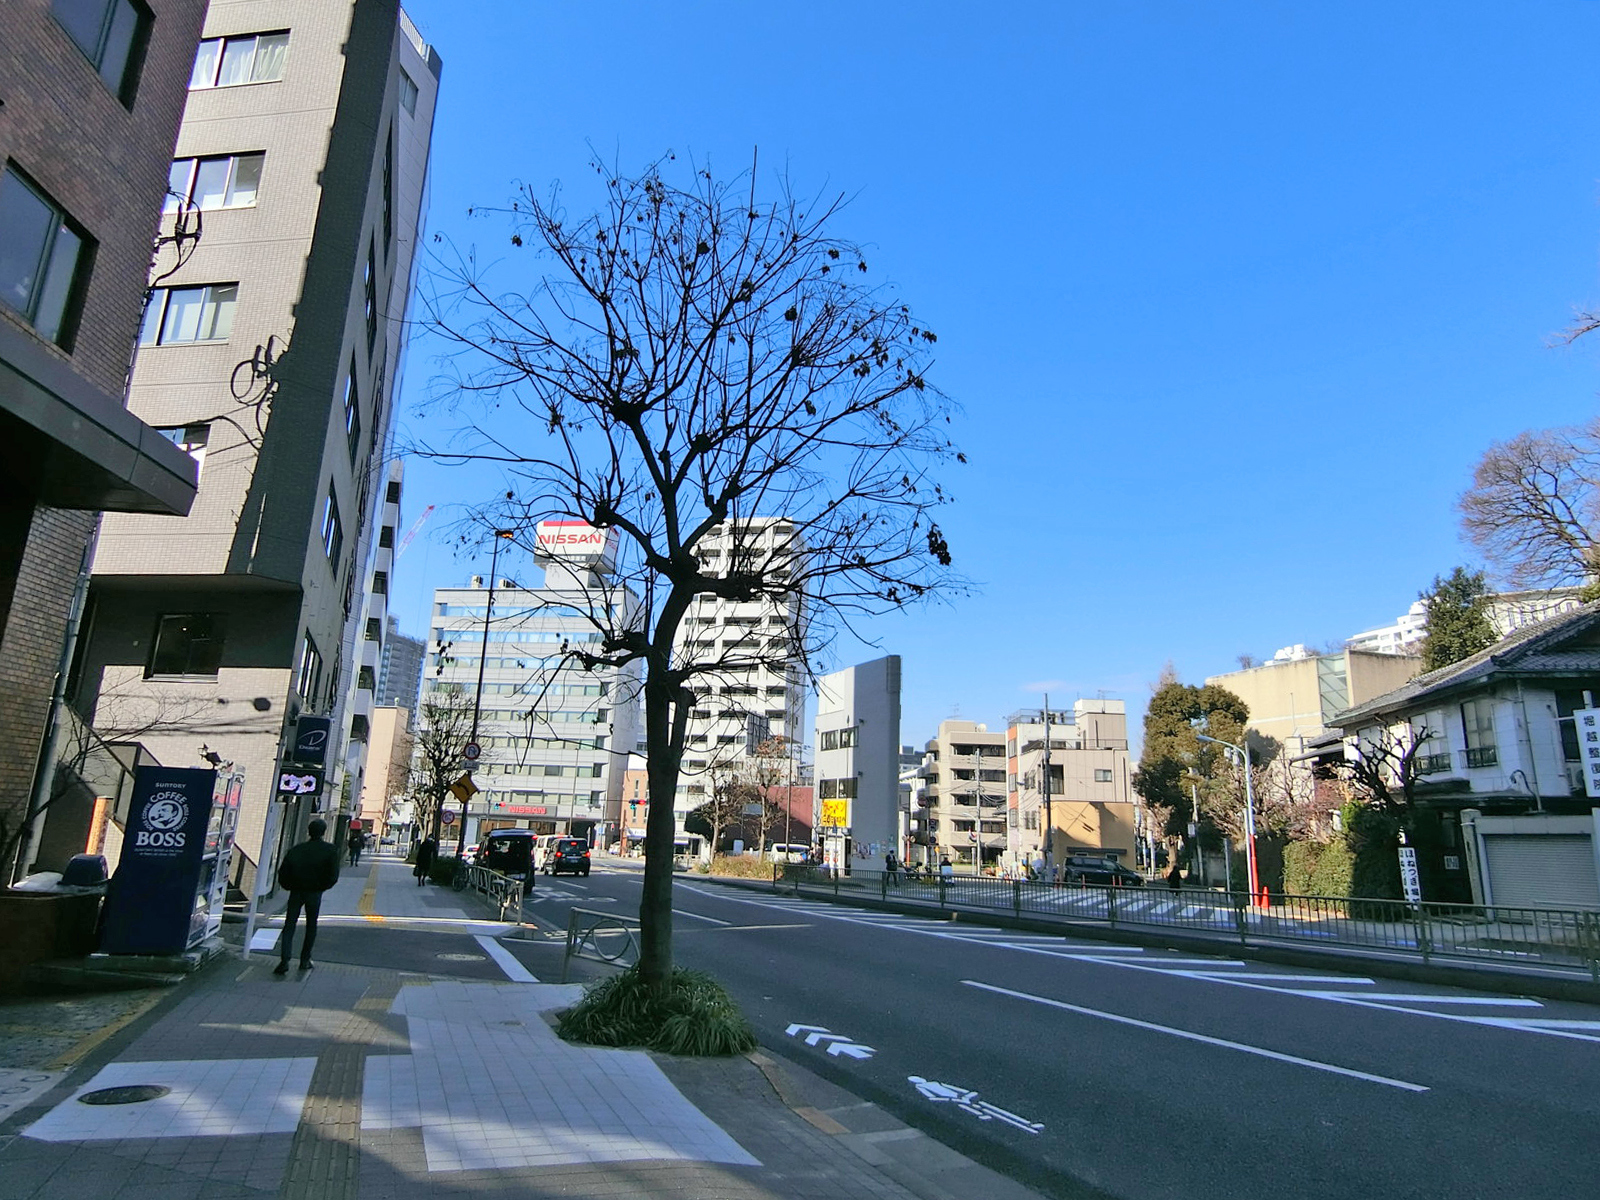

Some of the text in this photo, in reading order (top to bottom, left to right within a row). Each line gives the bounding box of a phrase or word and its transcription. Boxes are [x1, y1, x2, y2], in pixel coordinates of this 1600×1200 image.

[539, 534, 602, 545] NISSAN
[150, 791, 188, 804] COFFEE
[508, 805, 547, 815] NISSAN
[135, 831, 186, 847] BOSS
